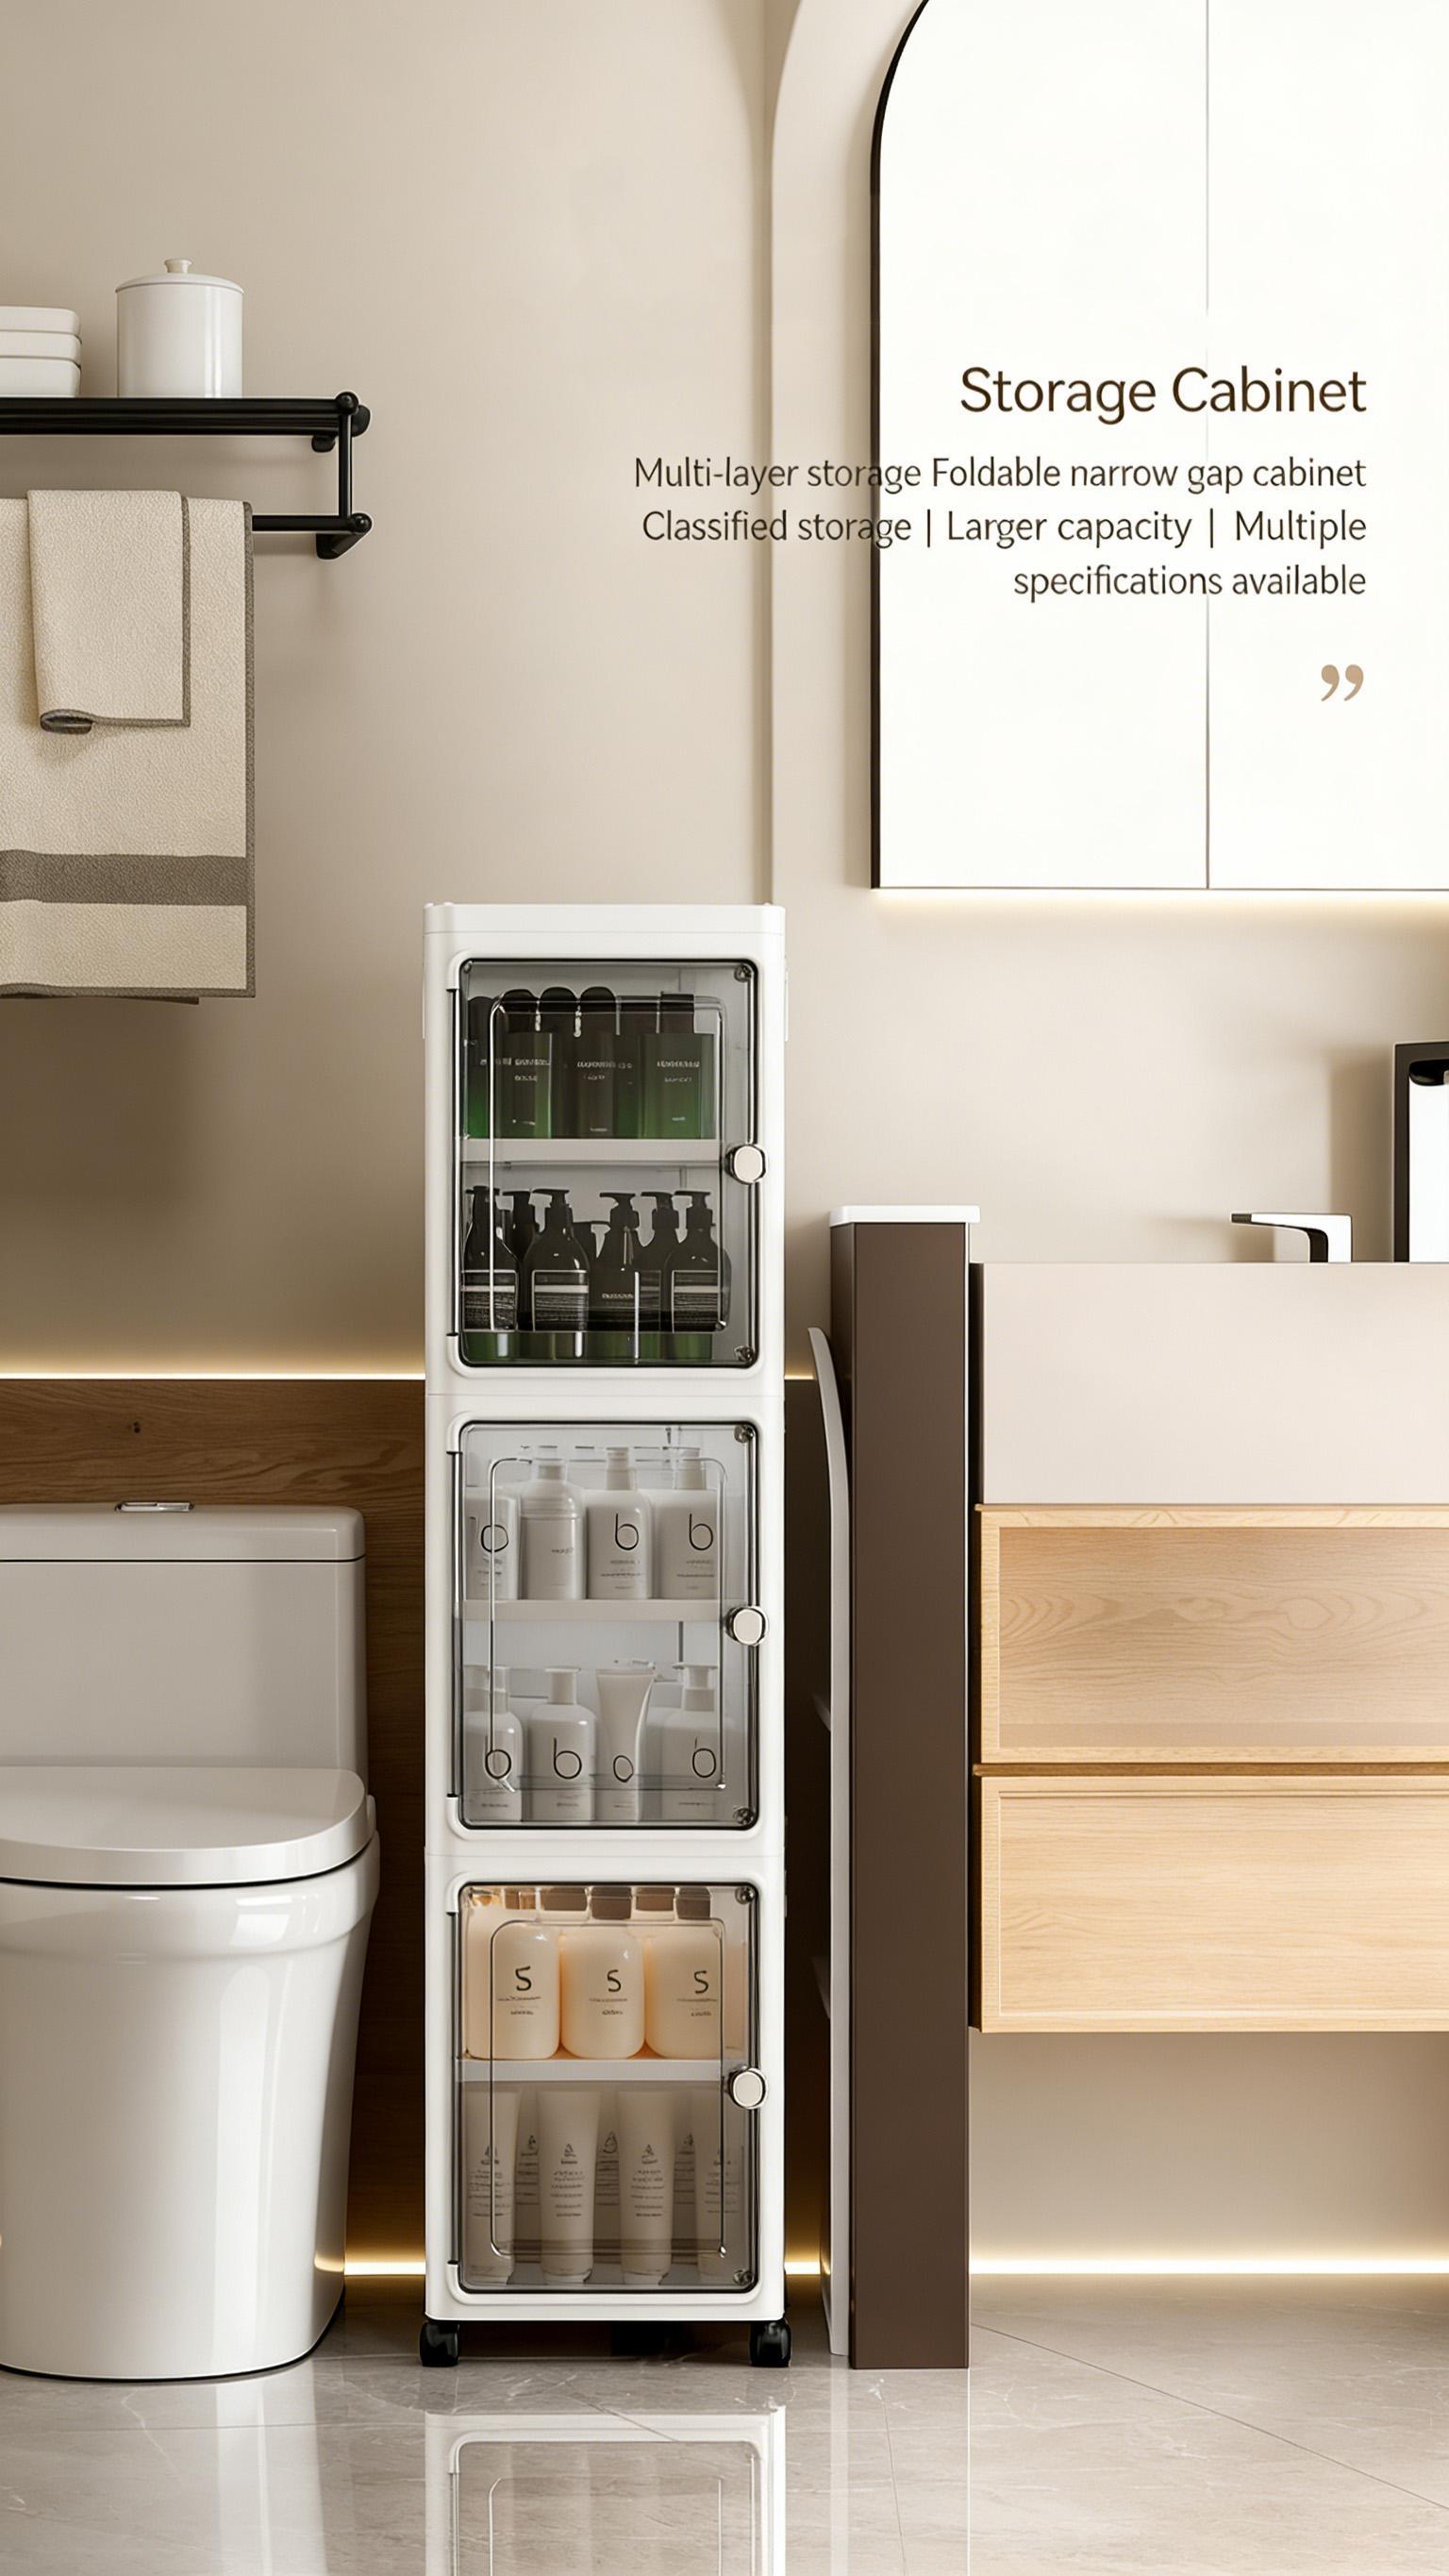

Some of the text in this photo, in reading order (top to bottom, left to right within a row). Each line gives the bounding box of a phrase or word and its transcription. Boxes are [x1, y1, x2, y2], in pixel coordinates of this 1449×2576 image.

[614, 1513, 640, 1551] b
[689, 1513, 714, 1551] b
[553, 1736, 582, 1780] b
